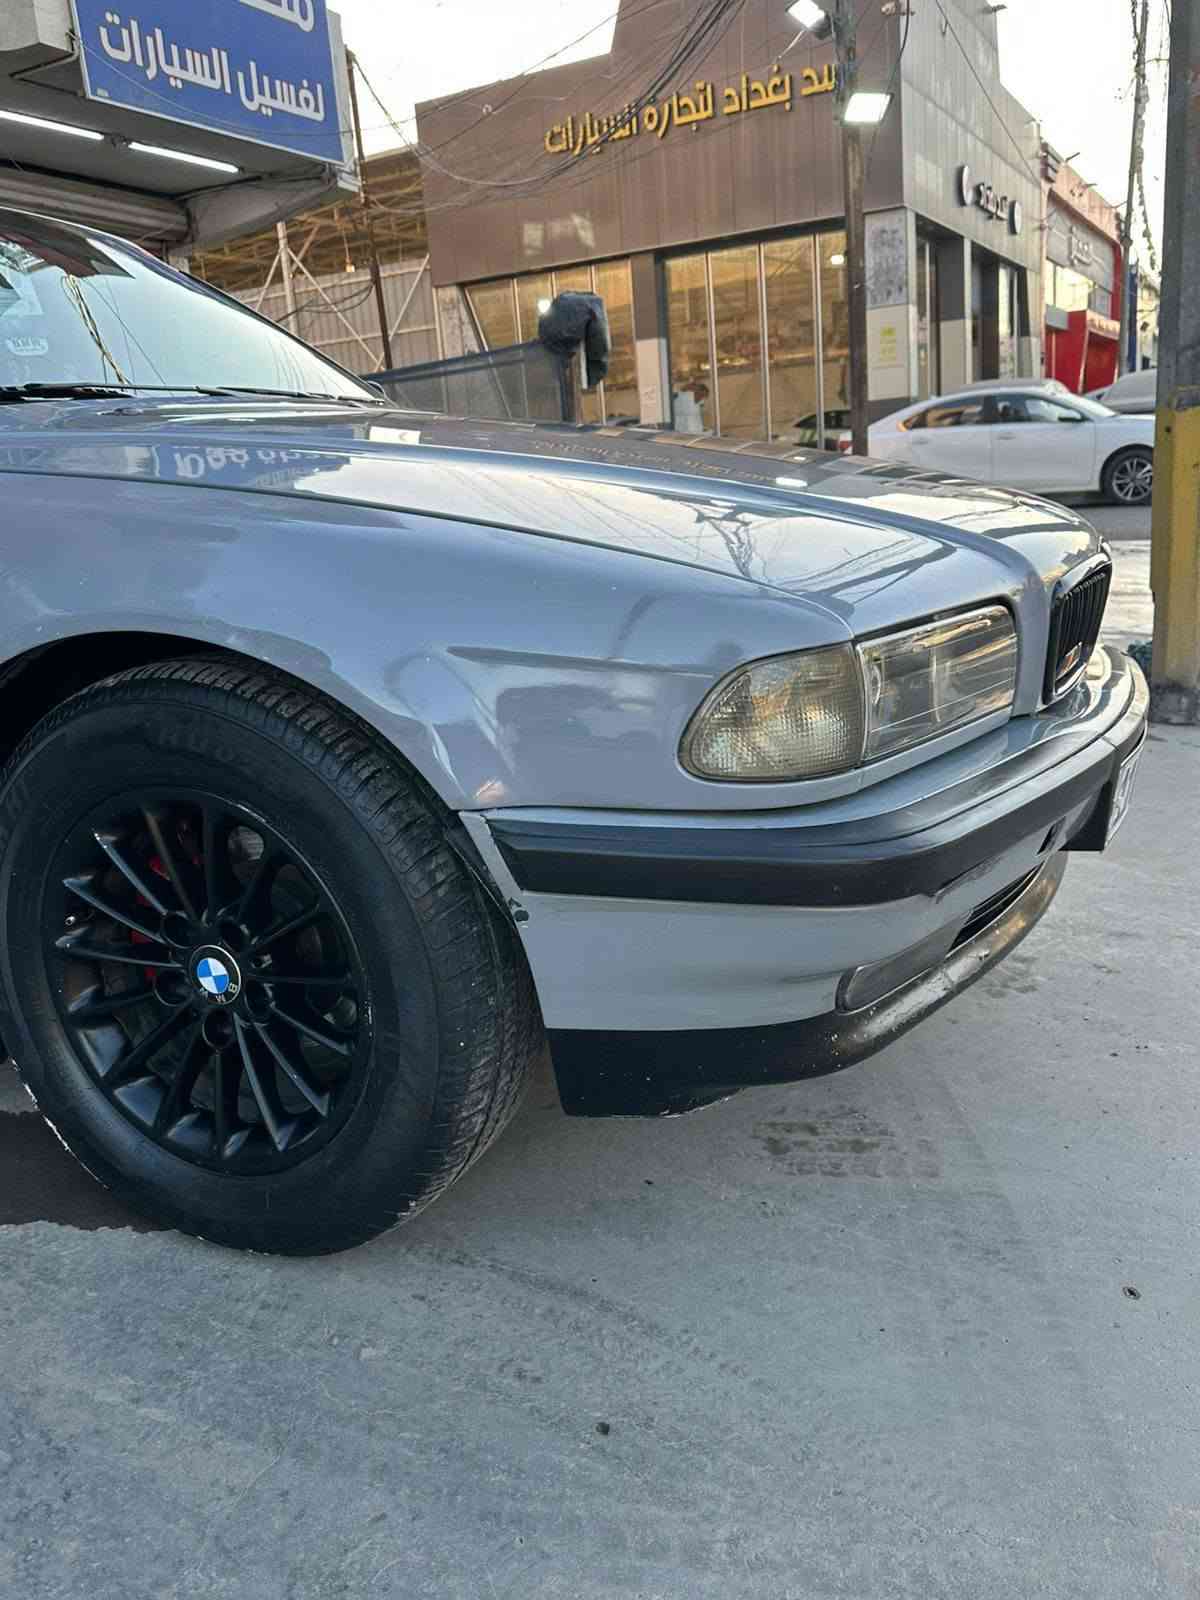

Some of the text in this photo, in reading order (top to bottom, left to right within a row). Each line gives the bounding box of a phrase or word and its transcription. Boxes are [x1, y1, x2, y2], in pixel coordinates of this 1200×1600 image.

[99, 12, 232, 94] السيارات
[237, 61, 325, 122] لغسيل
[723, 64, 793, 115] بغداد
[543, 103, 637, 155] السيارات
